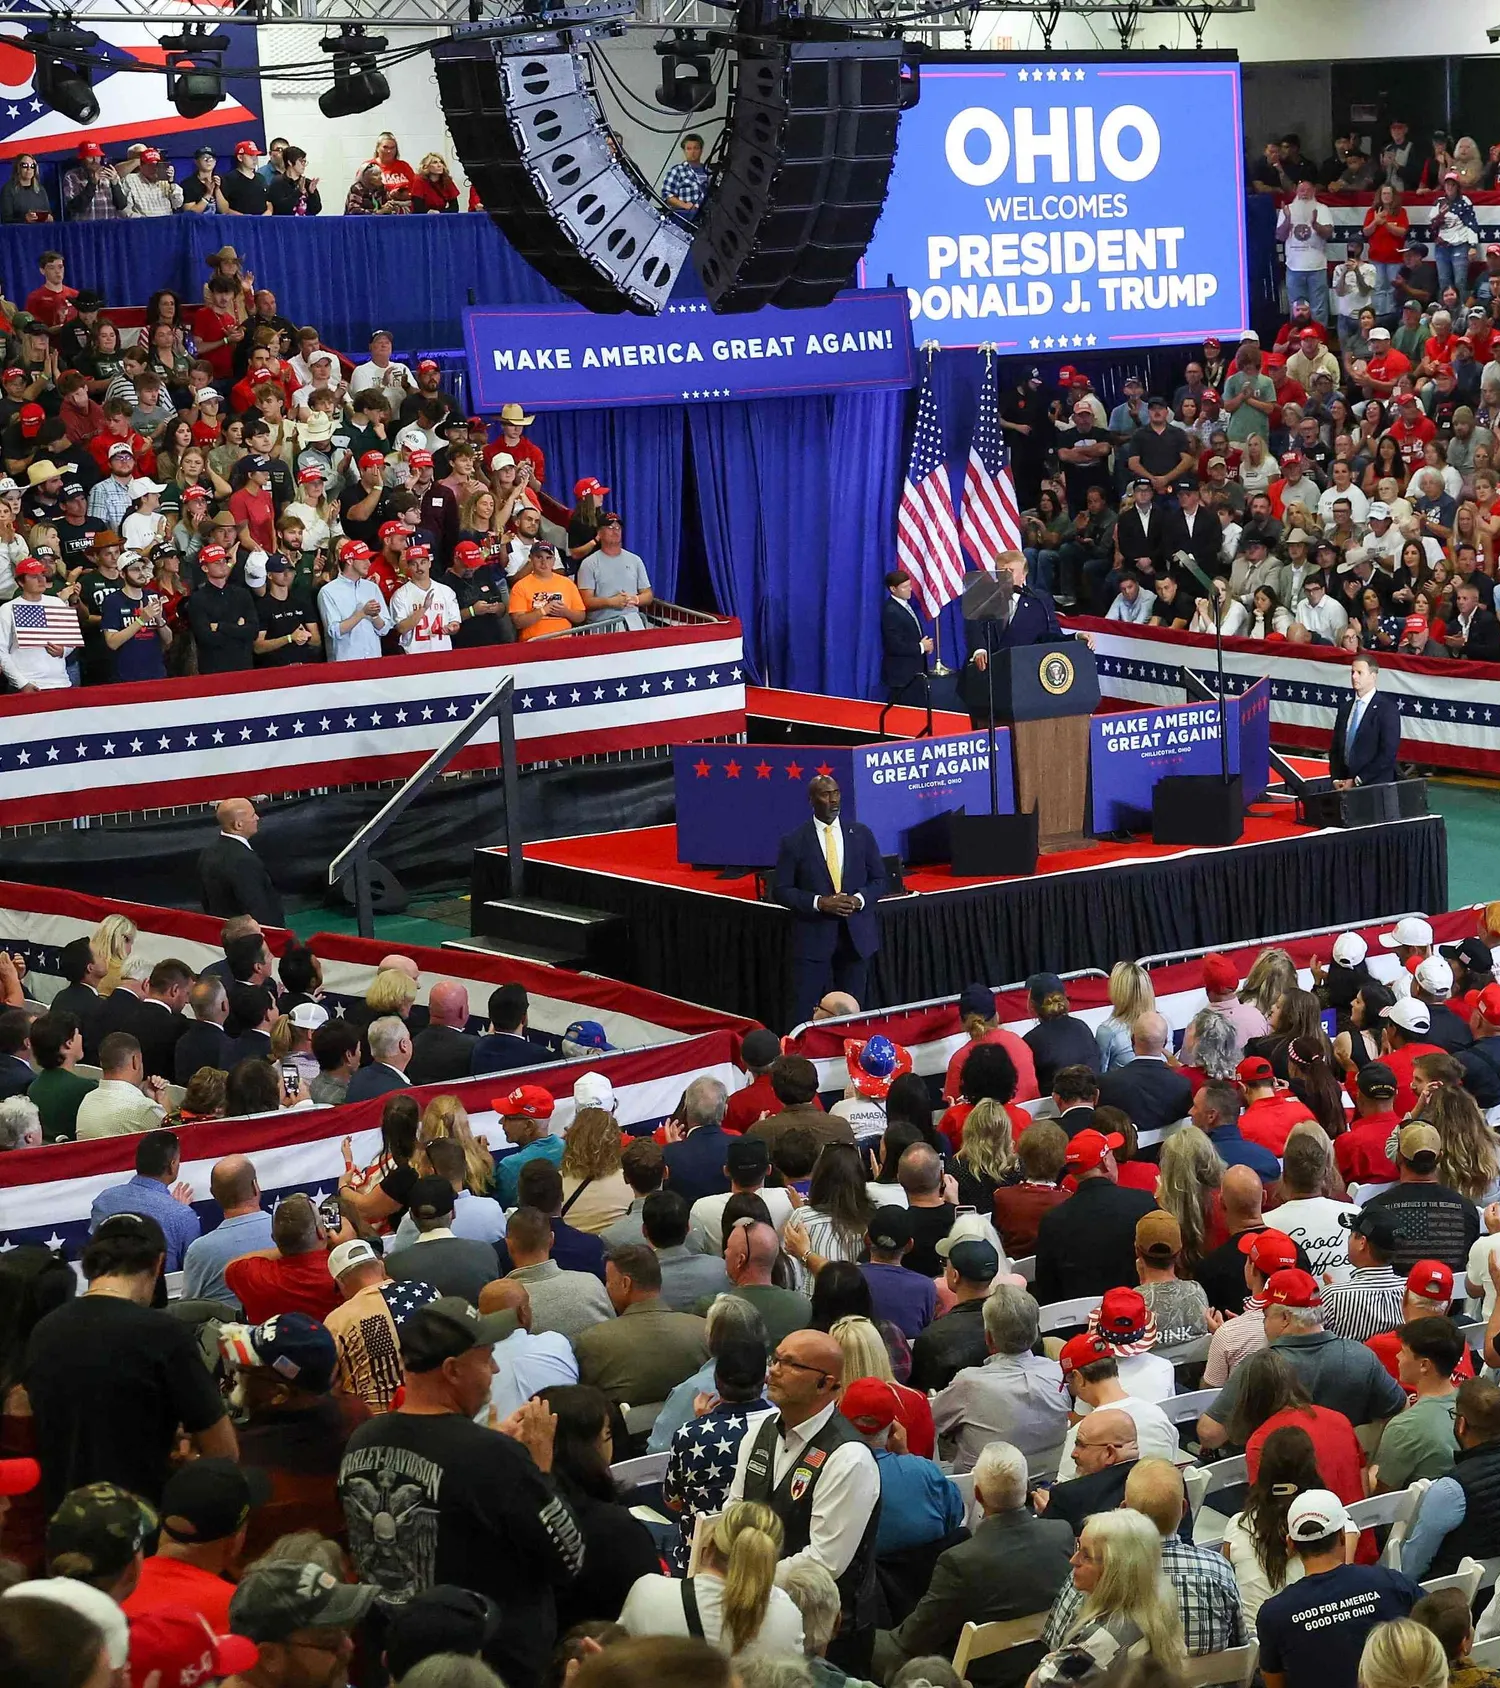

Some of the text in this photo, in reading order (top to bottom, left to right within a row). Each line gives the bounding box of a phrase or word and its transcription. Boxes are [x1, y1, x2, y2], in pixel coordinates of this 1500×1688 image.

[944, 104, 1161, 187] OHIO
[985, 193, 1128, 222] WELCOMES
[927, 226, 1185, 280] PRESIDENT
[1062, 279, 1091, 314] J.
[1098, 273, 1218, 312] TRUMP
[493, 329, 894, 372] MAKE AMERICA GREAT AGAIN!
[412, 603, 445, 611] DATON
[415, 613, 443, 641] 24
[1101, 717, 1149, 737] MAKE
[1107, 724, 1223, 752] GREAT AGAIN!
[866, 739, 999, 768] MAKE AMERICA
[872, 756, 990, 784] GREAT AGAIN
[850, 1111, 887, 1121] RAMASW
[1156, 1325, 1192, 1343] RINK
[337, 1446, 445, 1504] HARLEY-DAVIDSON
[1292, 1591, 1381, 1624] GOOD FOR AMERICA
[1305, 1604, 1375, 1632] GOOD FOR OHIO
